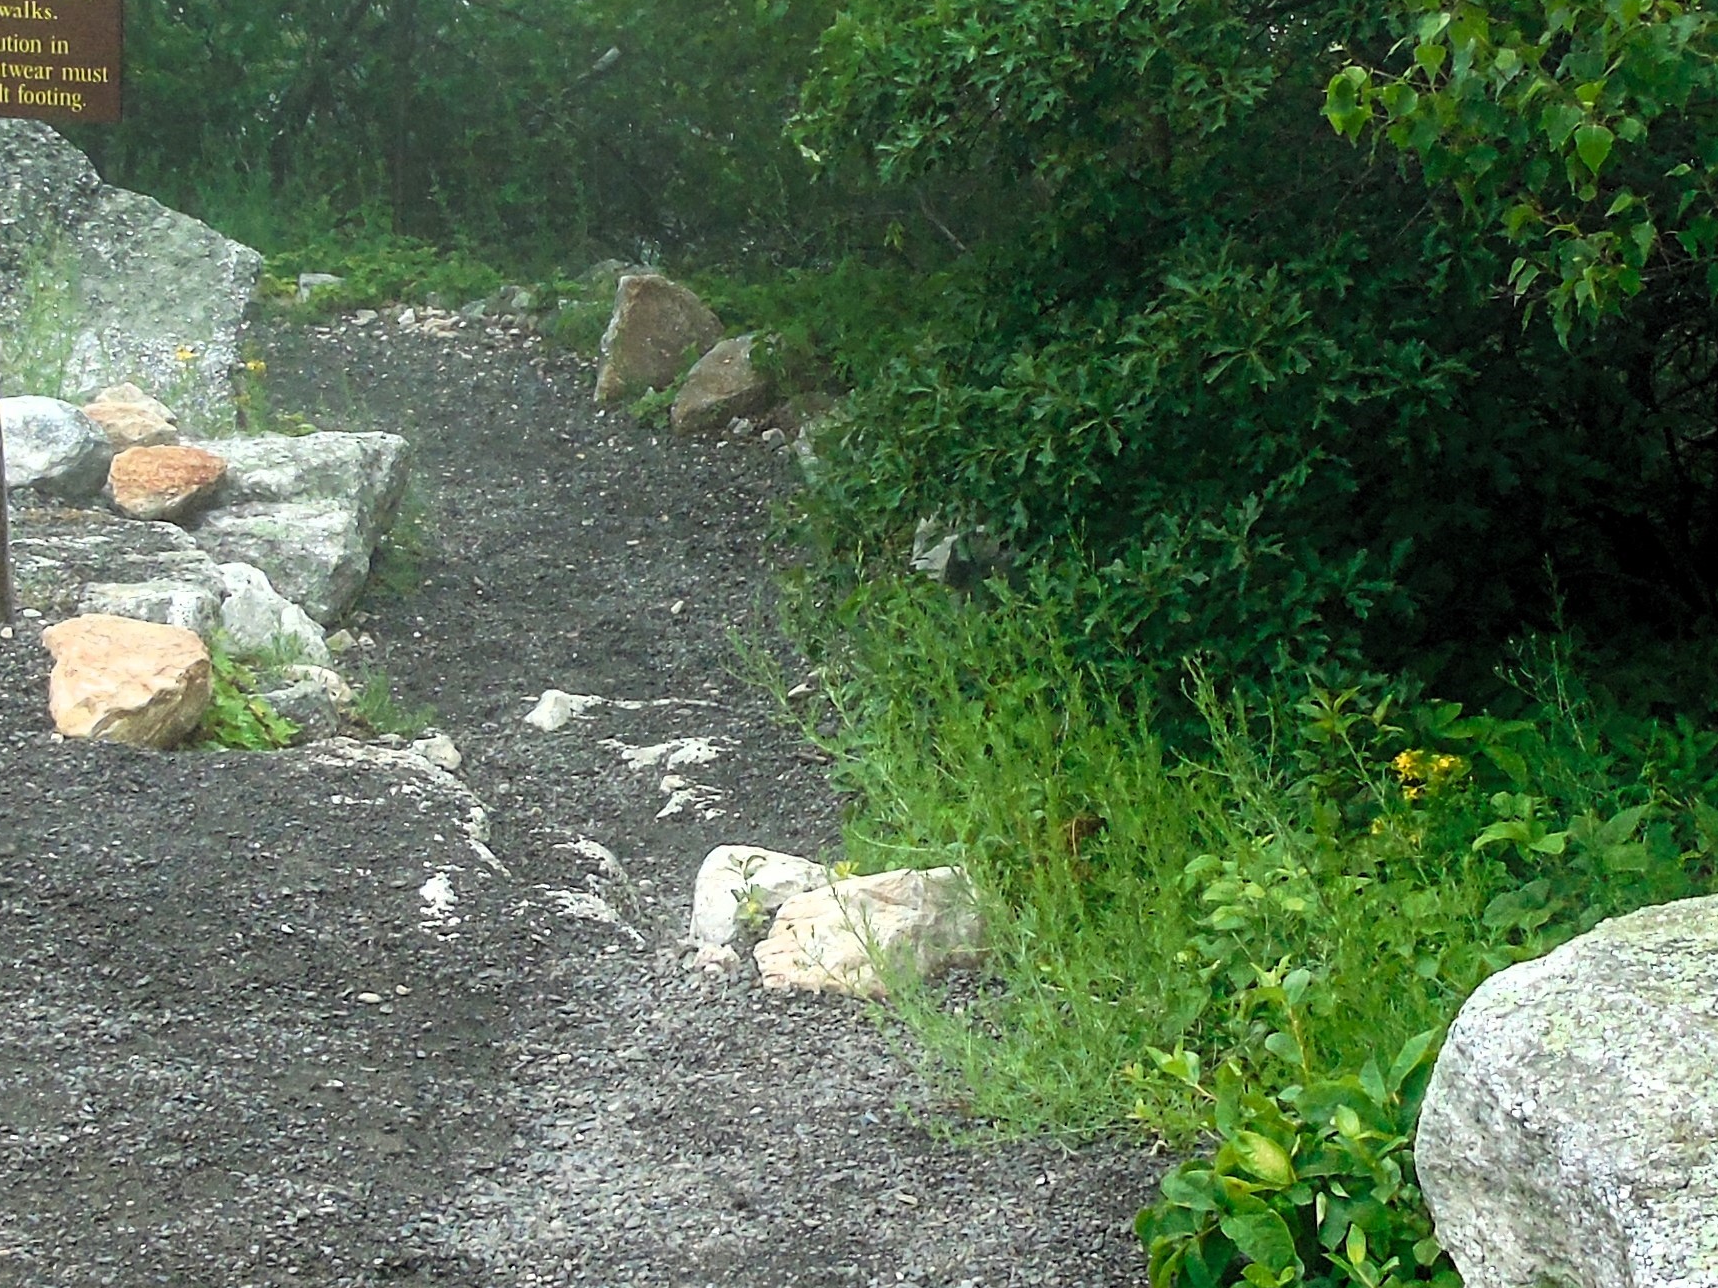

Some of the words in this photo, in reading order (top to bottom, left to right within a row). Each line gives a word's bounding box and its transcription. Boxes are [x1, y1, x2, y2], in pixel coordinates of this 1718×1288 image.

[50, 35, 70, 54] in
[61, 65, 109, 84] must
[17, 85, 87, 112] footing.
